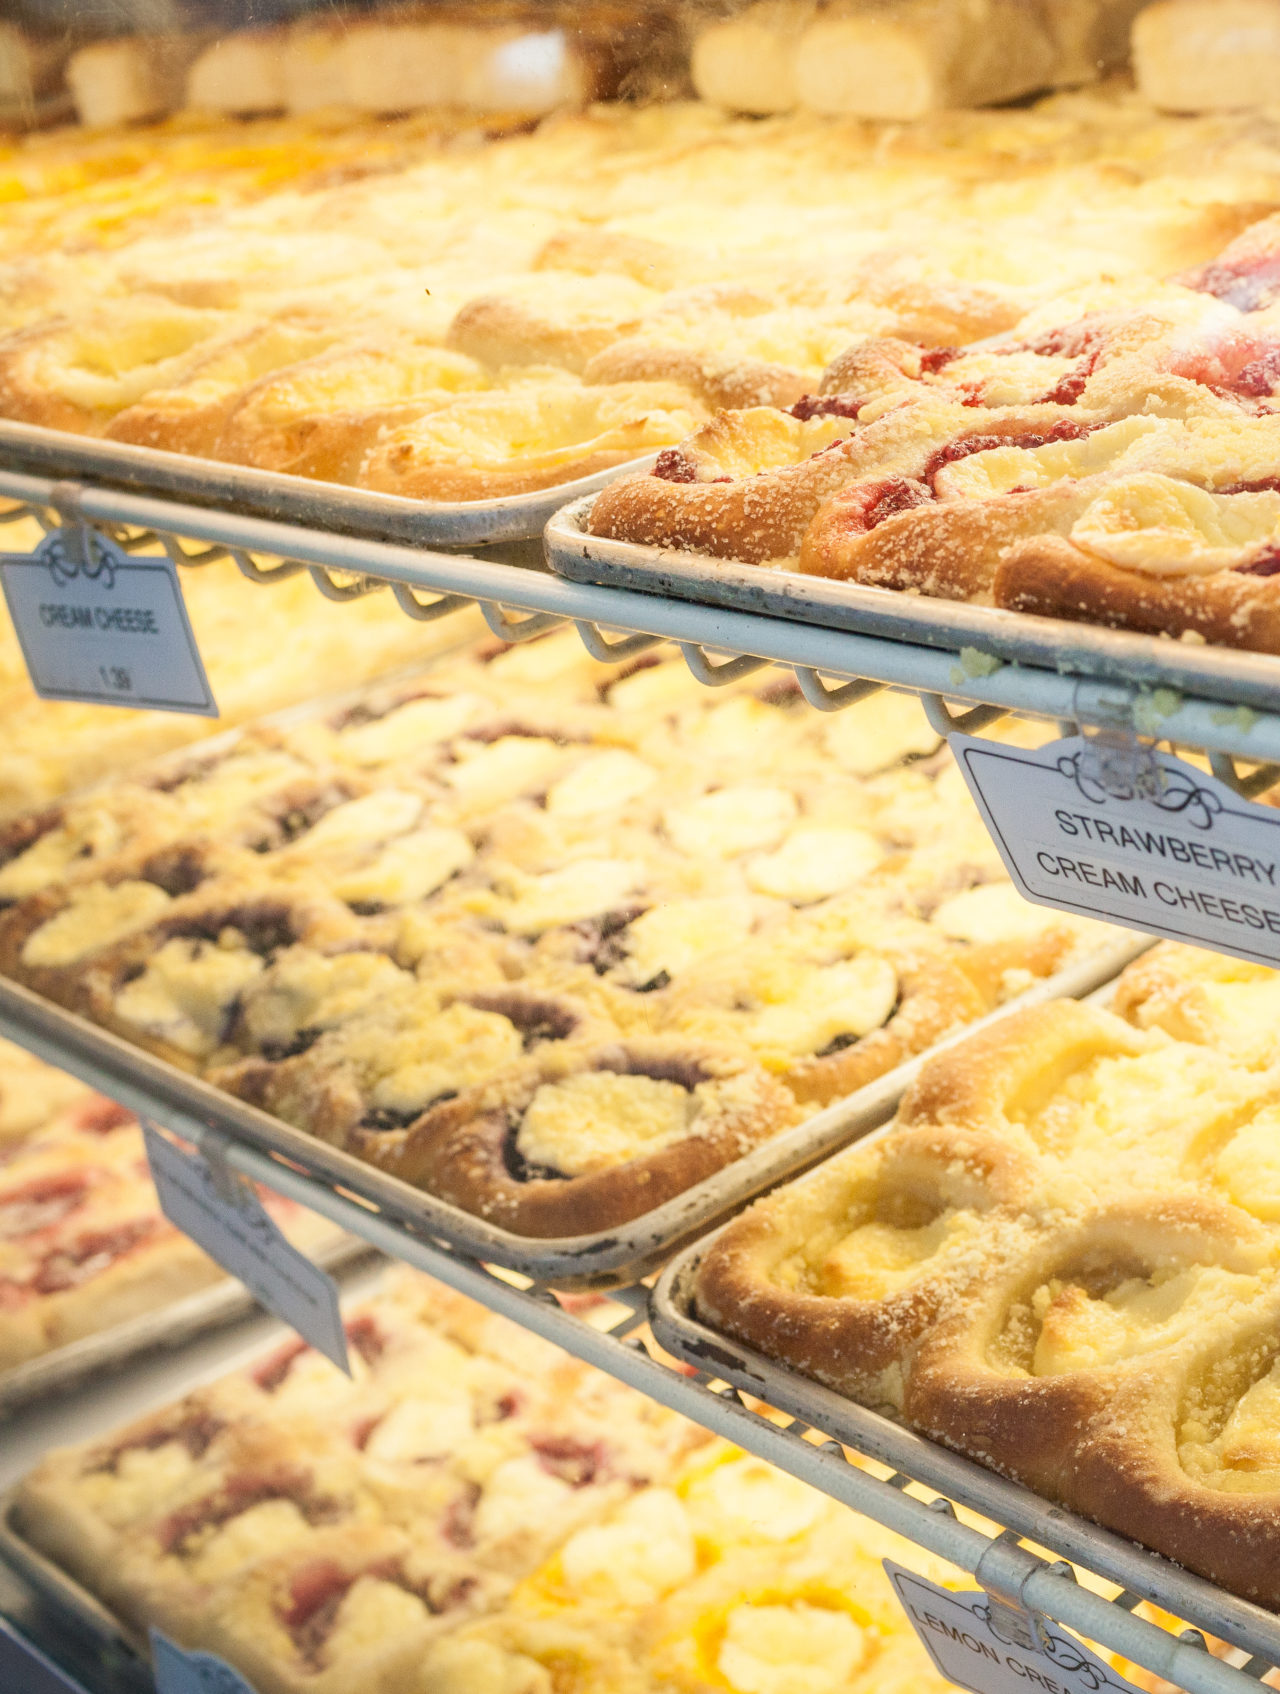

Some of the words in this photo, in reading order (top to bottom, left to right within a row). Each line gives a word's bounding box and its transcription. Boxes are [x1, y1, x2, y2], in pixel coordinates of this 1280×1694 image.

[39, 603, 94, 629] CREAM
[94, 606, 159, 634] CHEESE
[1054, 809, 1277, 886] STRAWBERRY
[1036, 851, 1147, 899] CREAM
[910, 1604, 1001, 1665] LEMON
